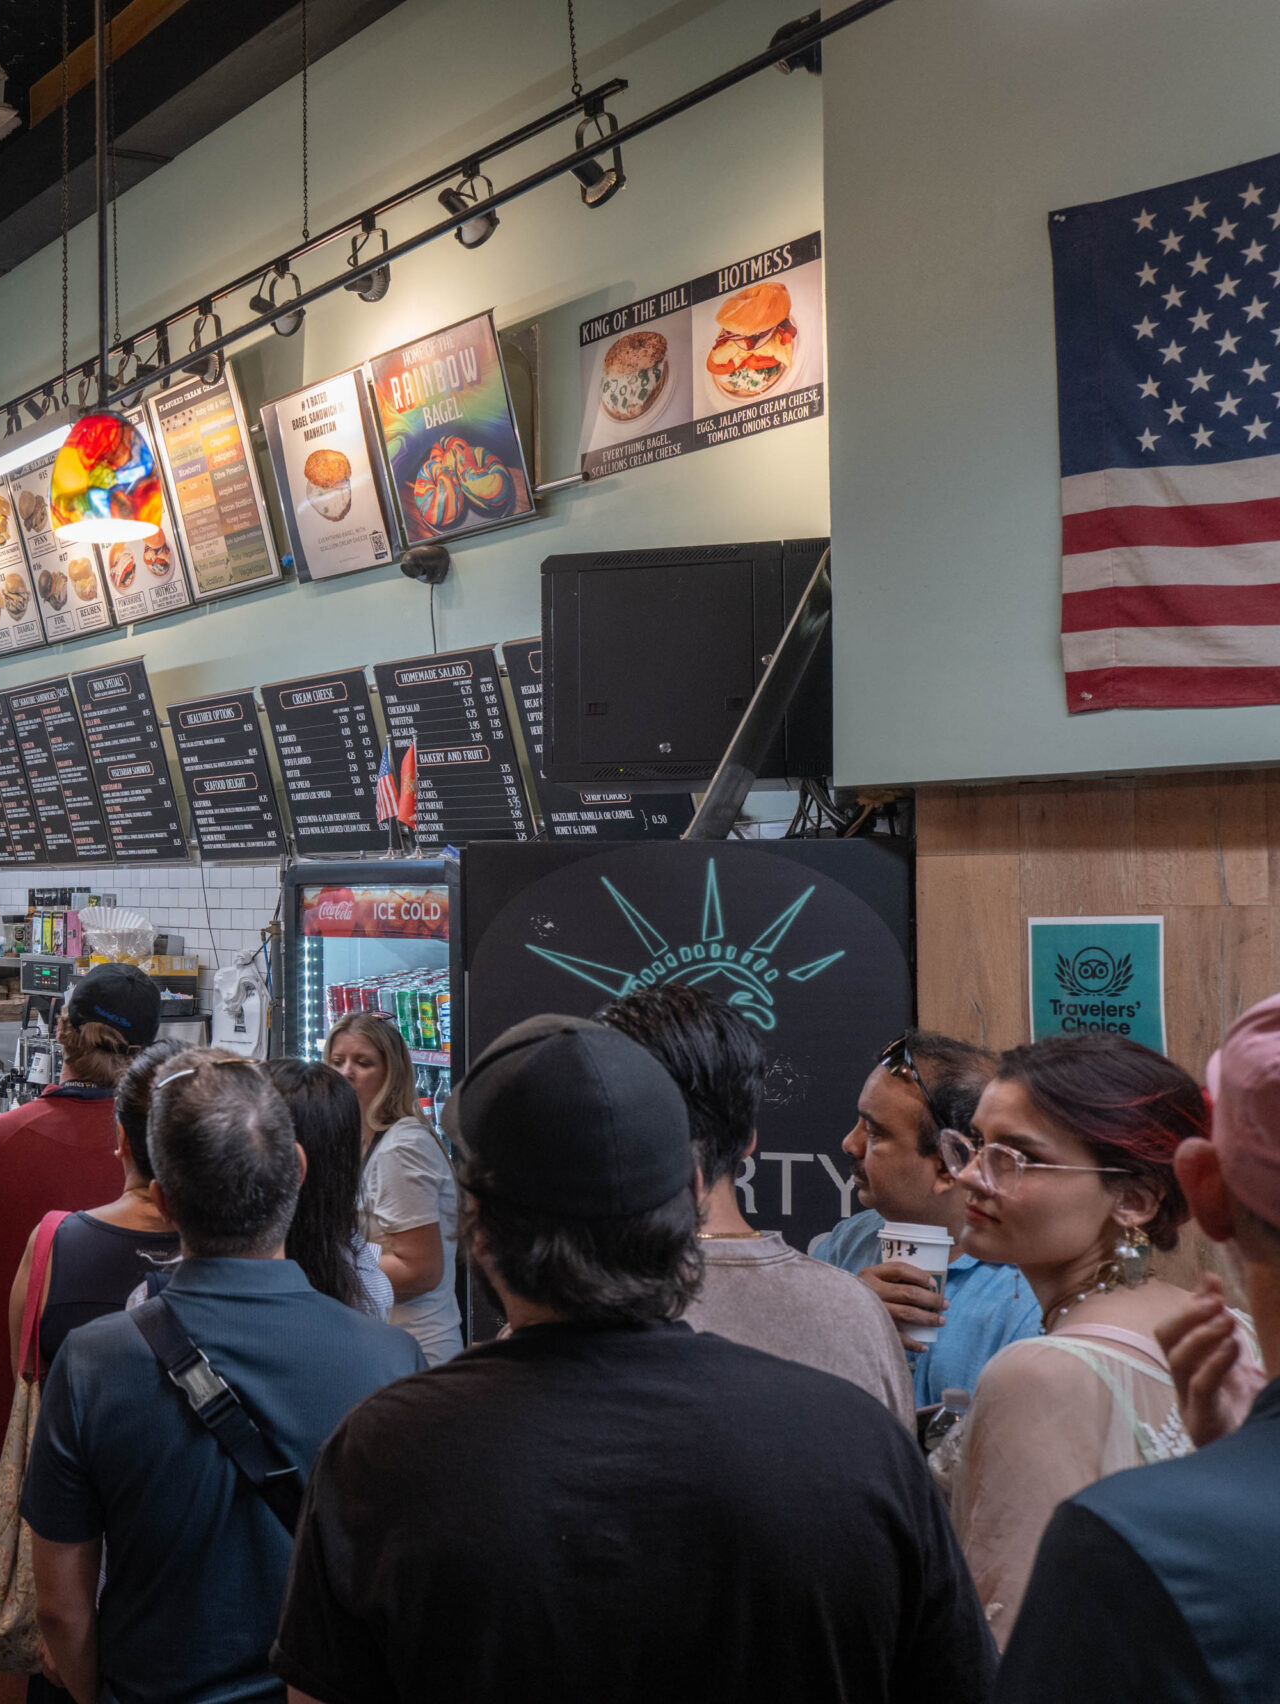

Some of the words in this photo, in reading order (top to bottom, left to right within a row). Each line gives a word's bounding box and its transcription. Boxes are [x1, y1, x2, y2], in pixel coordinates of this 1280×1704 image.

[718, 245, 794, 293] HOTMESS
[582, 319, 610, 344] KING
[613, 310, 629, 330] OF
[632, 299, 656, 324] THE
[660, 287, 688, 313] HILL
[401, 345, 425, 368] HOME
[390, 346, 479, 411] RAINBOW
[291, 413, 309, 432] BAGEL
[309, 402, 338, 426] SANDWICH
[422, 396, 464, 430] BAGEL
[718, 406, 758, 430] JALAPENO
[759, 398, 787, 418] CREAM
[742, 416, 771, 436] ONIONS
[773, 413, 781, 425] &
[781, 404, 810, 424] BACON
[303, 420, 337, 443] MANHATTAN
[591, 456, 628, 478] SCALLIONS
[629, 449, 654, 468] CREAM
[655, 442, 682, 461] CHEESE
[602, 440, 645, 463] EVERYTHING
[32, 535, 48, 547] PENN
[79, 606, 102, 620] REUBEN
[401, 667, 439, 684] HOMEMADE
[439, 664, 466, 679] SALADS
[292, 690, 312, 705] CREAM
[312, 687, 334, 703] CHEESE
[461, 686, 472, 695] 6.75
[480, 683, 494, 694] 10.95
[405, 703, 420, 714] SALAD
[485, 694, 497, 704] 9.95
[524, 697, 539, 709] DECAF
[186, 710, 213, 725] HEALTHIER
[213, 707, 235, 721] OPTIONS
[392, 728, 401, 737] EGG
[469, 720, 480, 730] 3.95
[489, 718, 502, 729] 7.95
[471, 732, 483, 742] 3.95
[492, 730, 505, 740] 7.95
[419, 752, 447, 765] BAKERY
[448, 751, 462, 763] AND
[463, 749, 485, 761] FRUIT
[203, 778, 226, 793] SEAFOOD
[226, 777, 247, 790] DELIGHT
[503, 775, 514, 785] 3.50
[505, 787, 517, 797] 3.50
[423, 811, 438, 821] SALAD
[580, 810, 603, 821] VANILLA
[611, 809, 635, 820] CARMEL
[652, 814, 668, 825] 0.50
[554, 825, 572, 836] HONEY
[579, 825, 597, 835] LEMON
[318, 901, 355, 921] Coca-Cola
[373, 902, 396, 921] ICE
[401, 902, 441, 921] COLD
[1061, 1017, 1131, 1035] Choice
